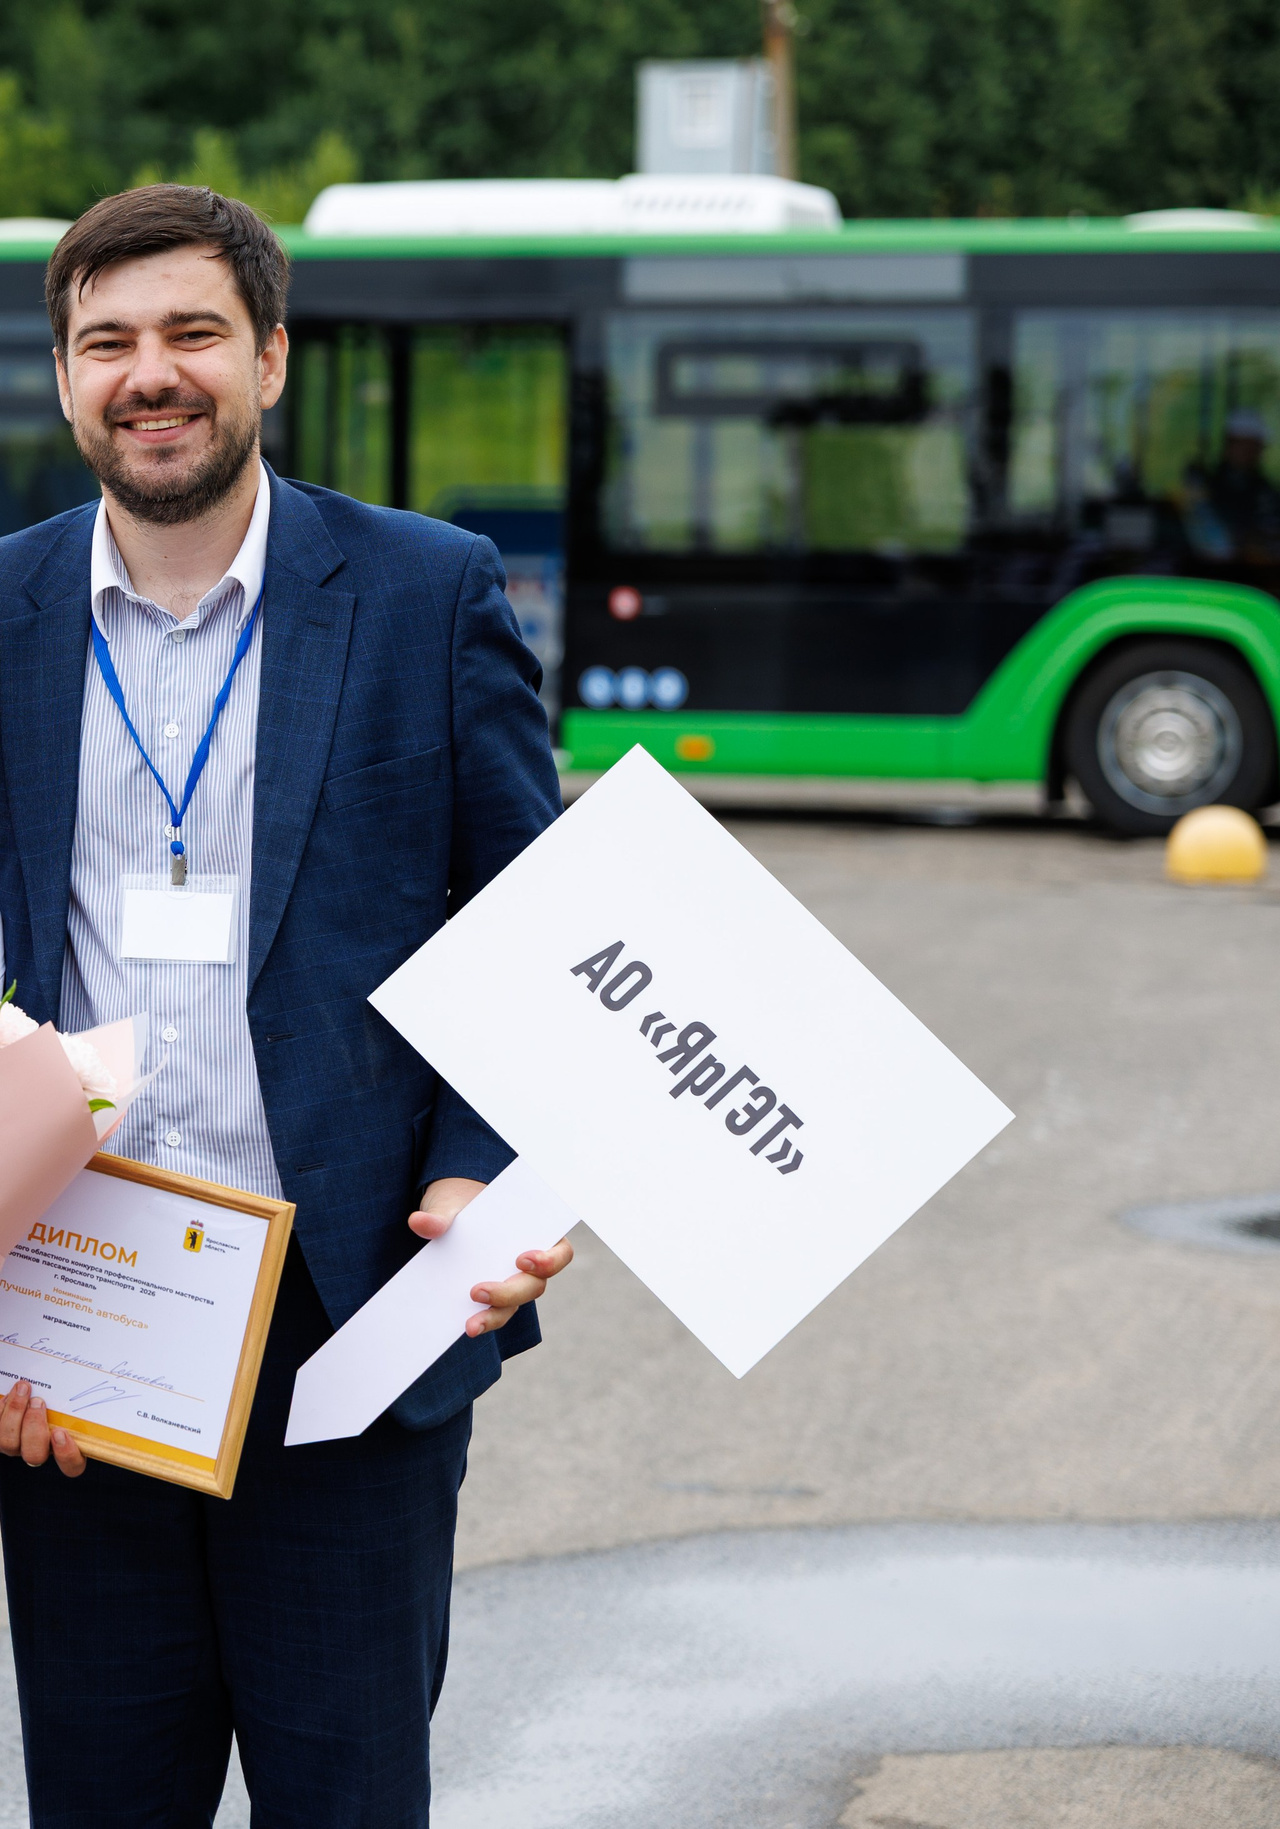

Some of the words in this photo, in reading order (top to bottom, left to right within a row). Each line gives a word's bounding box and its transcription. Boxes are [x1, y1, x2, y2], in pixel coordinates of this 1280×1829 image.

[569, 940, 653, 1012] АО
[638, 1010, 805, 1176] «ЯрГЭТ»
[27, 1222, 138, 1268] ДИПЛОМ
[204, 1243, 226, 1254] область
[205, 1237, 240, 1251] Ярославская
[30, 1247, 70, 1264] областного
[70, 1259, 103, 1274] конкурса
[103, 1268, 174, 1294] профессионального
[174, 1289, 215, 1306] мастерства
[41, 1259, 95, 1280] пассажирского
[95, 1274, 135, 1291] транспорта
[139, 1286, 156, 1297] 2026
[60, 1274, 97, 1291] Ярославль
[52, 1286, 93, 1303] Номинация
[42, 1313, 91, 1332] награждается
[43, 1293, 94, 1314] водитель
[96, 1308, 149, 1330] автобуса»
[136, 1410, 150, 1420] С.В.
[150, 1414, 202, 1435] Волканевский
